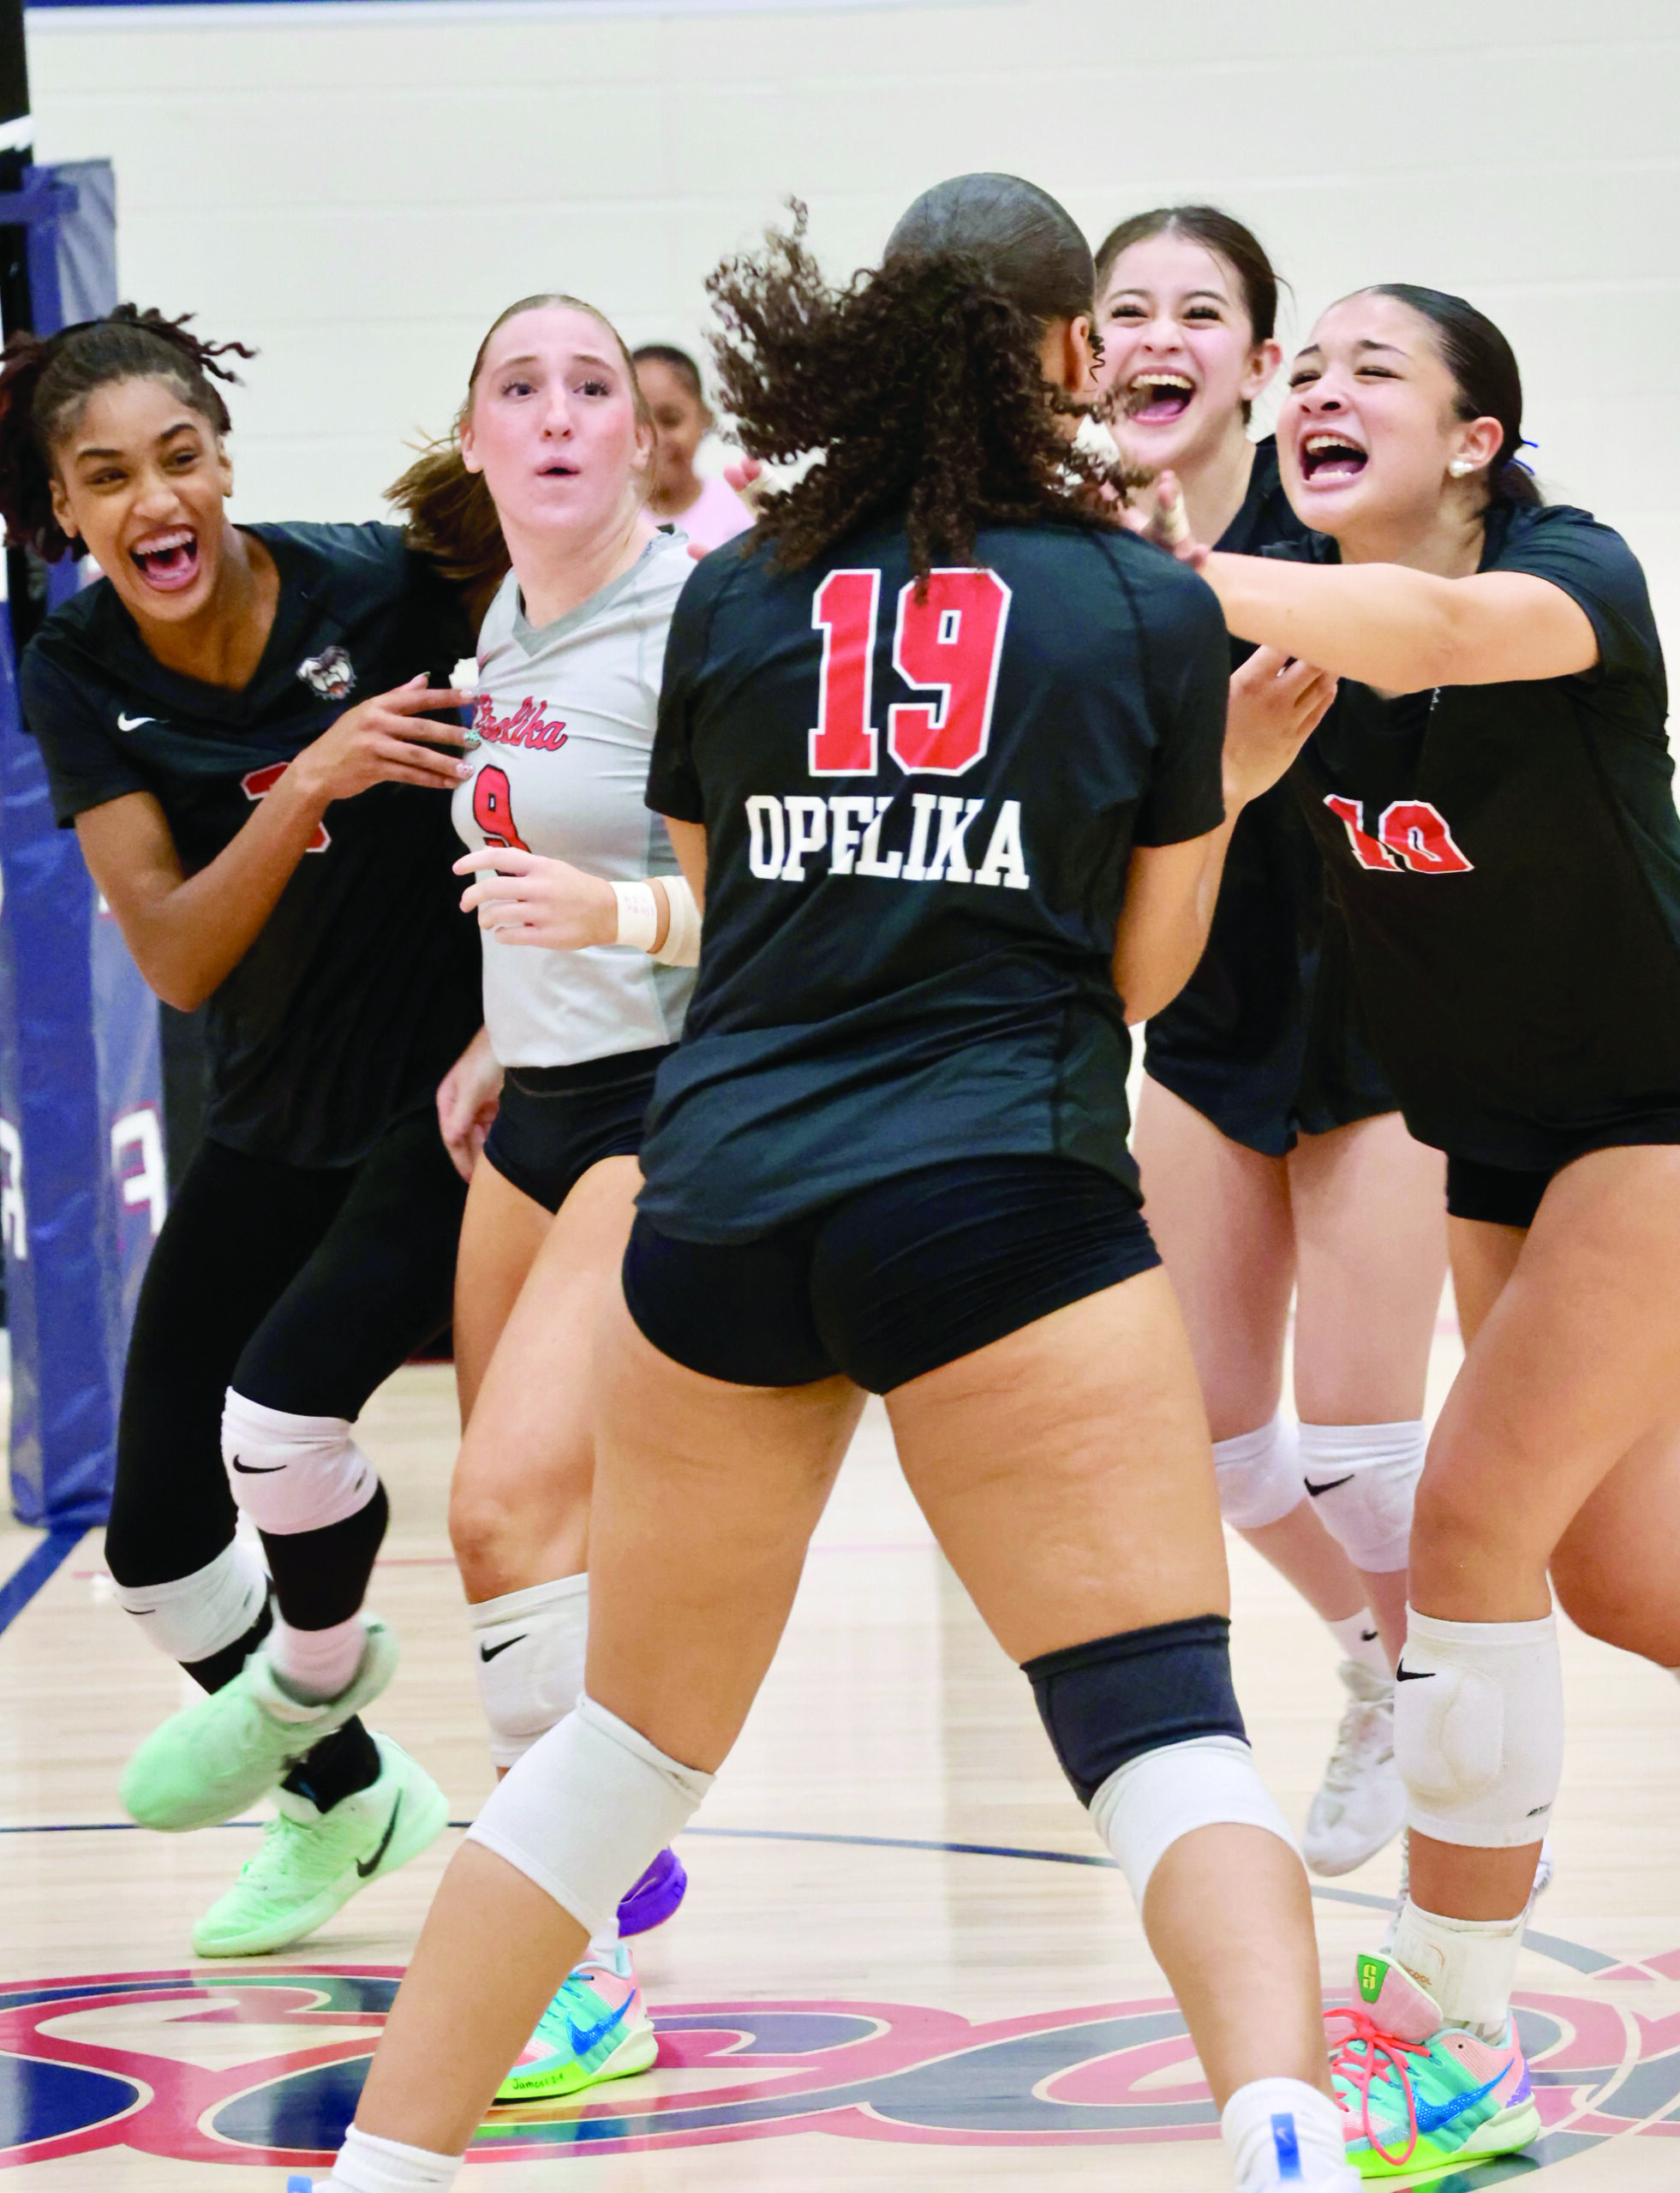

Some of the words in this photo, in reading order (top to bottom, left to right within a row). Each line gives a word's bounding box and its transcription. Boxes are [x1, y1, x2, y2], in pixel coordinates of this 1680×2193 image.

[808, 567, 1013, 777] 19
[472, 763, 533, 875] 9
[744, 792, 1030, 890] OPELIKA
[1323, 793, 1475, 874] 10
